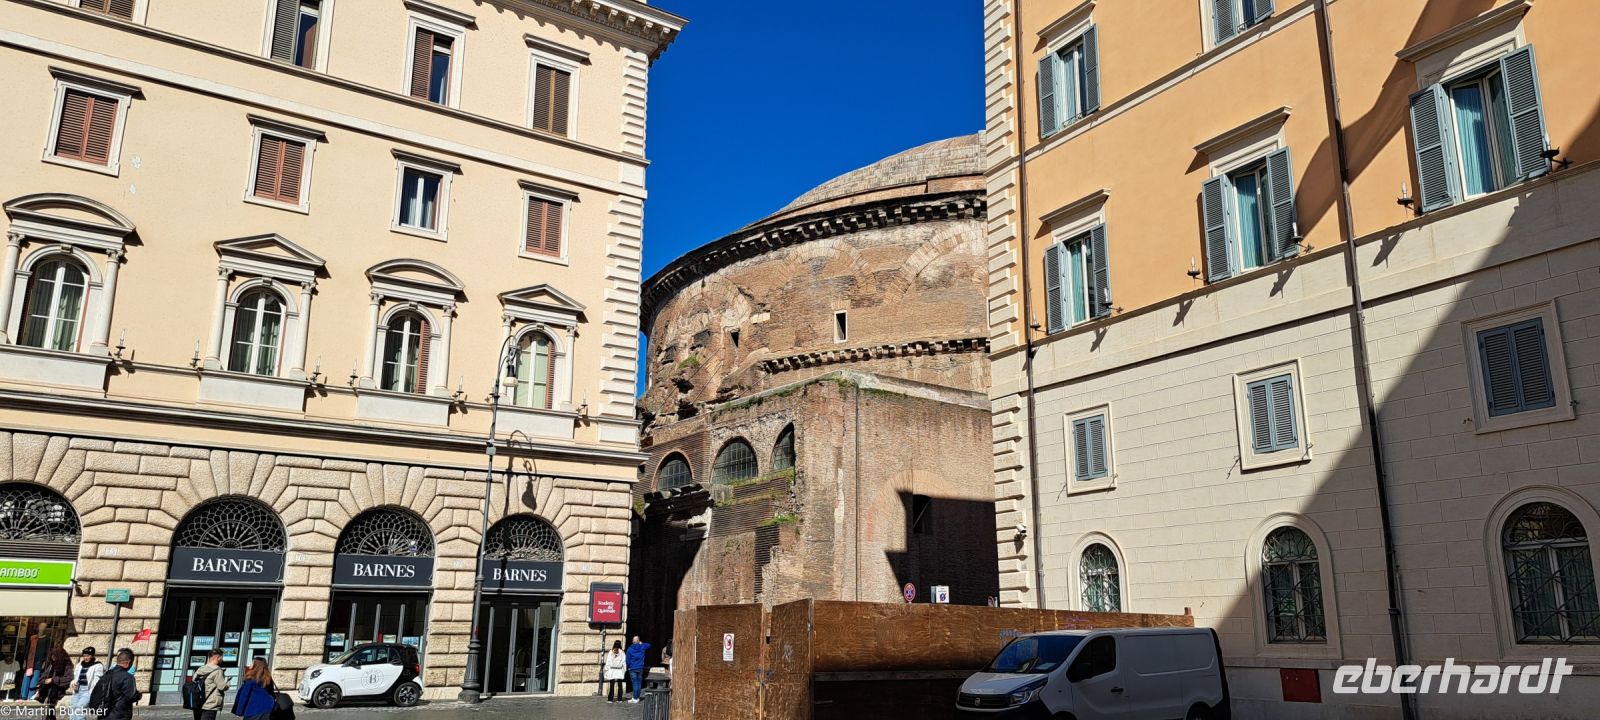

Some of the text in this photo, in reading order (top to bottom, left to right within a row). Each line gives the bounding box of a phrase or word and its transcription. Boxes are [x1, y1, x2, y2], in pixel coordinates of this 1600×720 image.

[191, 557, 264, 574] BARNES
[352, 562, 415, 578] BARNES
[492, 567, 547, 582] BARNES
